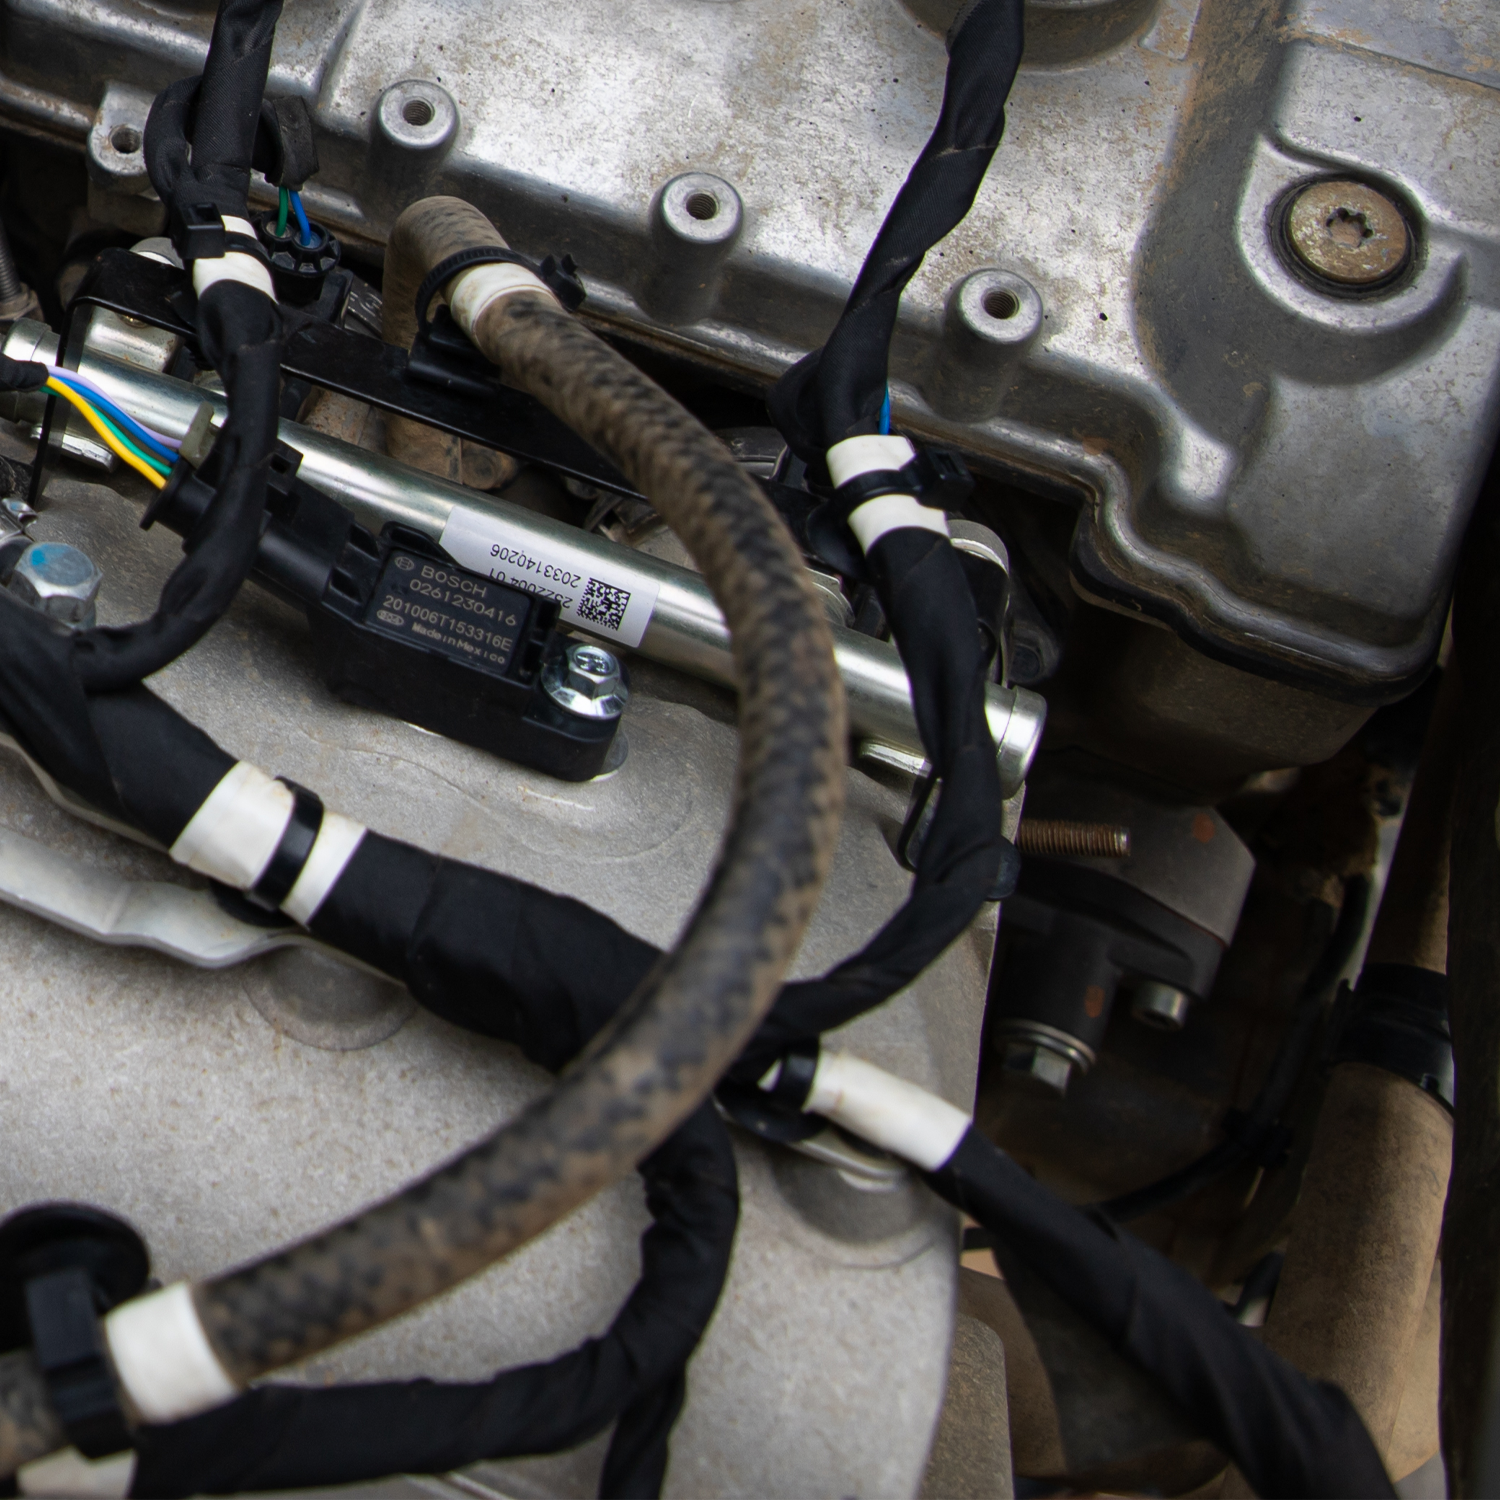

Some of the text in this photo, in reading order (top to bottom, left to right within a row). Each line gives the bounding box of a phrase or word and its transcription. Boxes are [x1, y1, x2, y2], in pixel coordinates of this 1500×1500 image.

[421, 565, 488, 598] BOSCH
[490, 543, 582, 588] 2033140206
[382, 595, 513, 652] 201006T153316E
[409, 578, 517, 627] 0261230416
